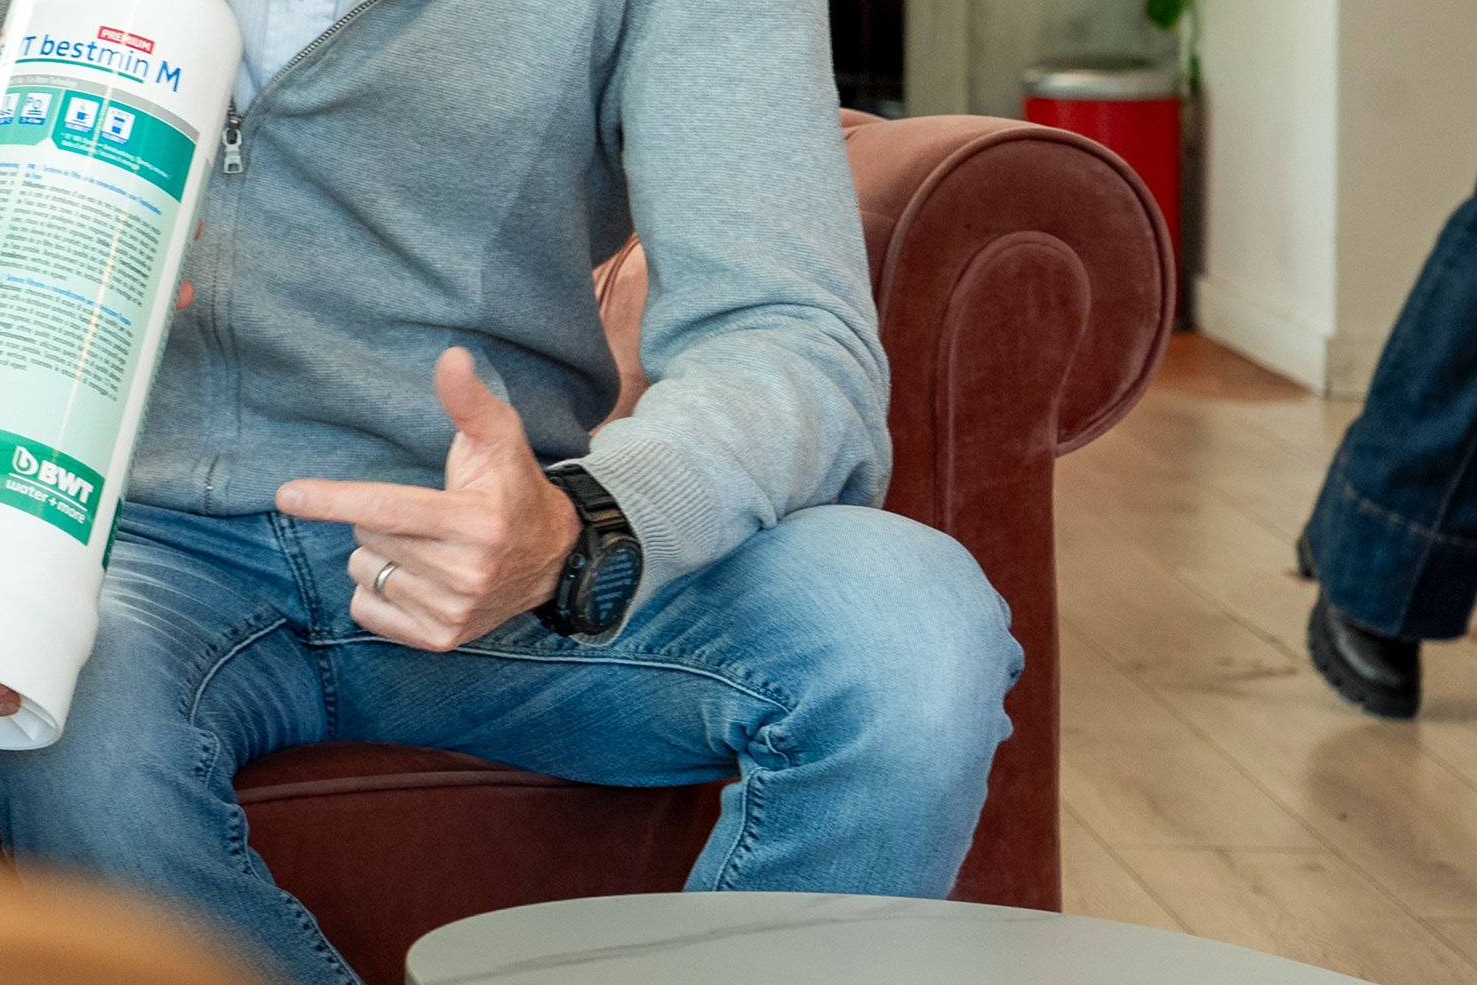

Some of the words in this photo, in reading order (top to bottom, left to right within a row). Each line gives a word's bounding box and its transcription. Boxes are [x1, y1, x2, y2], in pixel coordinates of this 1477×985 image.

[101, 28, 153, 52] PREMIUM
[40, 34, 149, 78] bestmin
[156, 60, 182, 93] M
[37, 459, 94, 504] BWT
